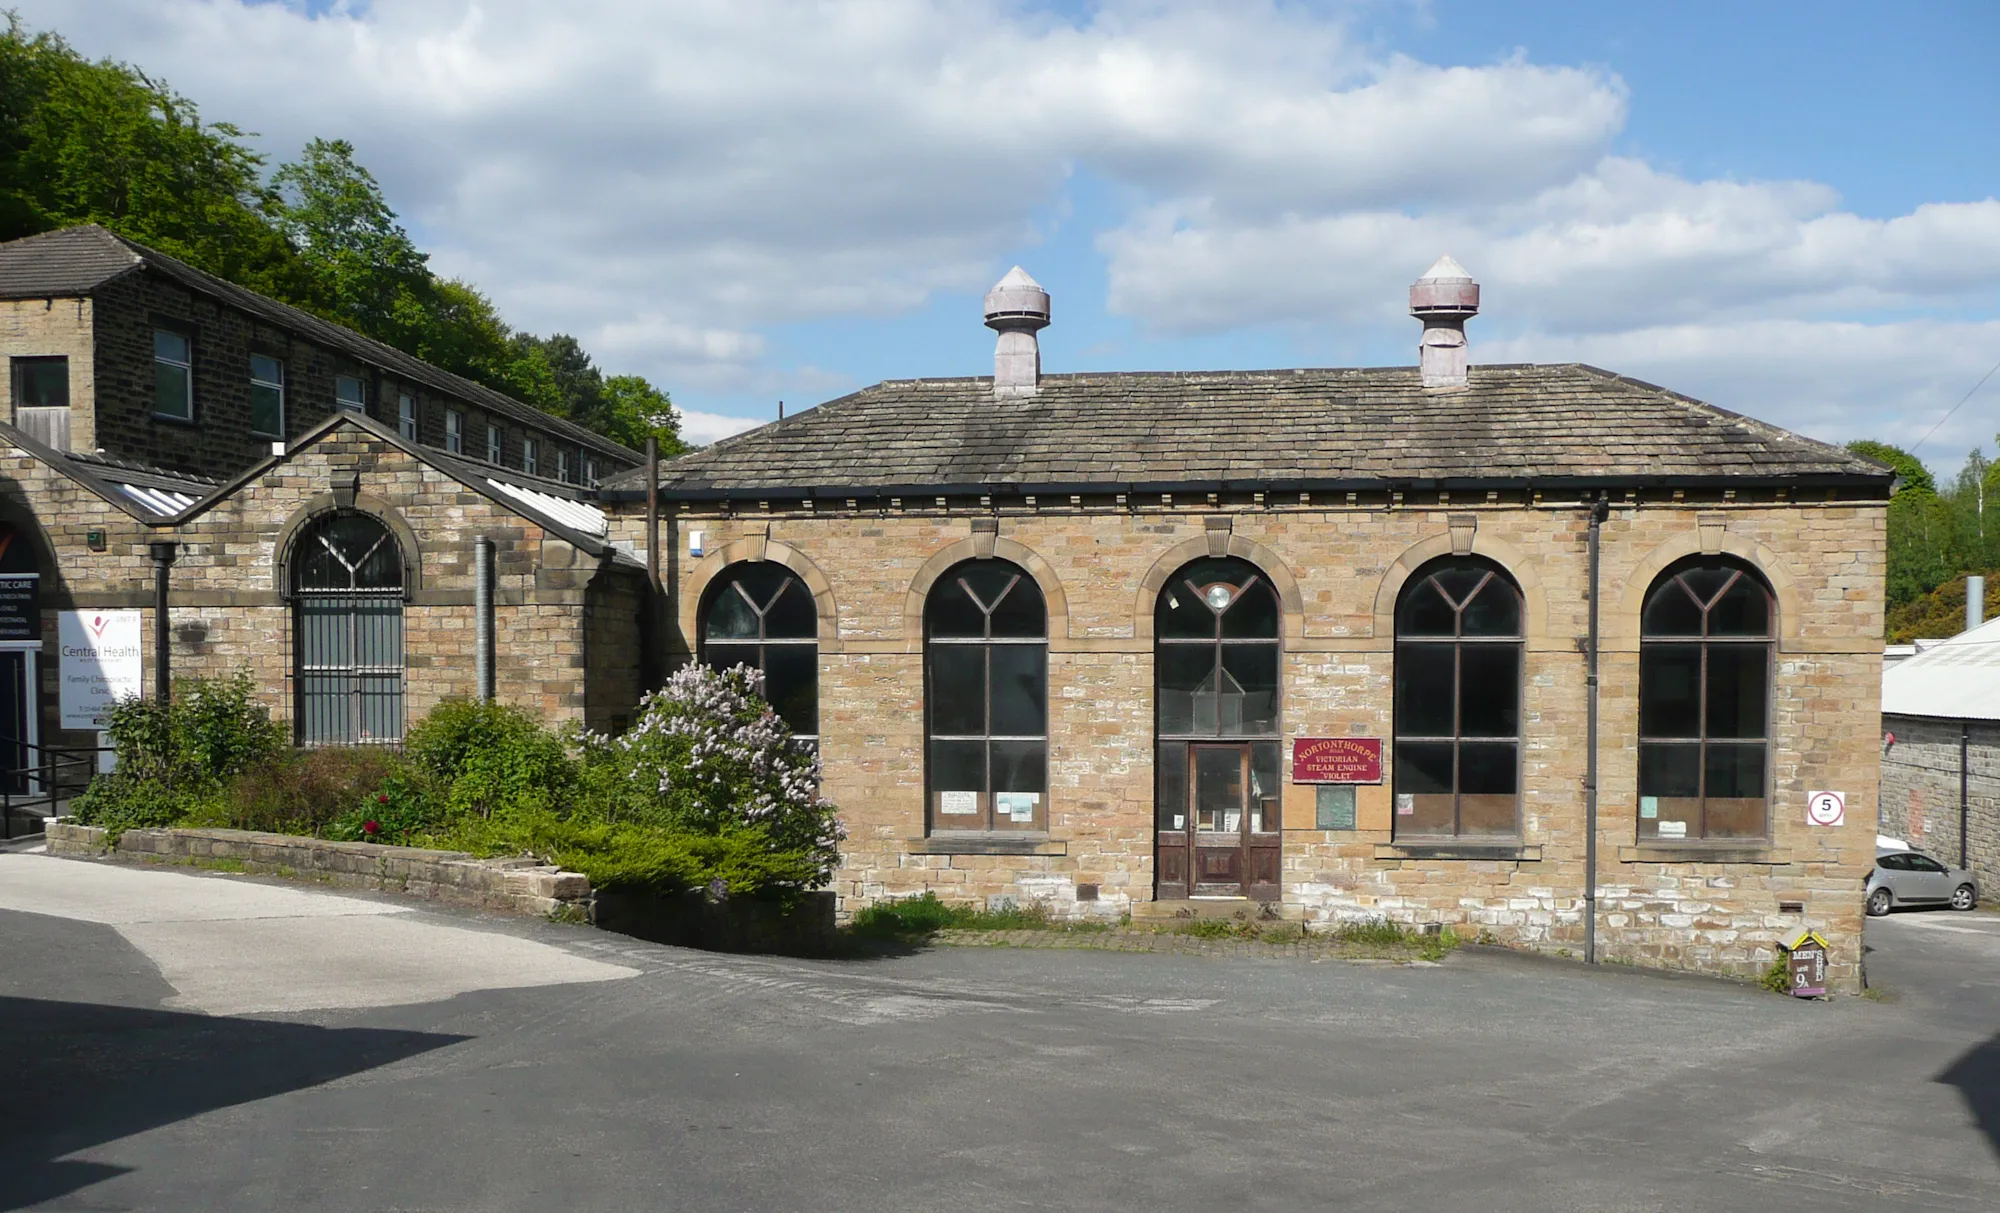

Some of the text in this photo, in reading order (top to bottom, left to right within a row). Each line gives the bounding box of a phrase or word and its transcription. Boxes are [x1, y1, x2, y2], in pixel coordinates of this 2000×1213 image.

[62, 645, 139, 657] Central Health
[67, 675, 132, 684] Family Chiropractic
[91, 686, 110, 695] Clinic
[1298, 740, 1377, 762] NORTONTHORPE
[1316, 755, 1358, 763] VICTORIAN
[1821, 799, 1831, 811] 5
